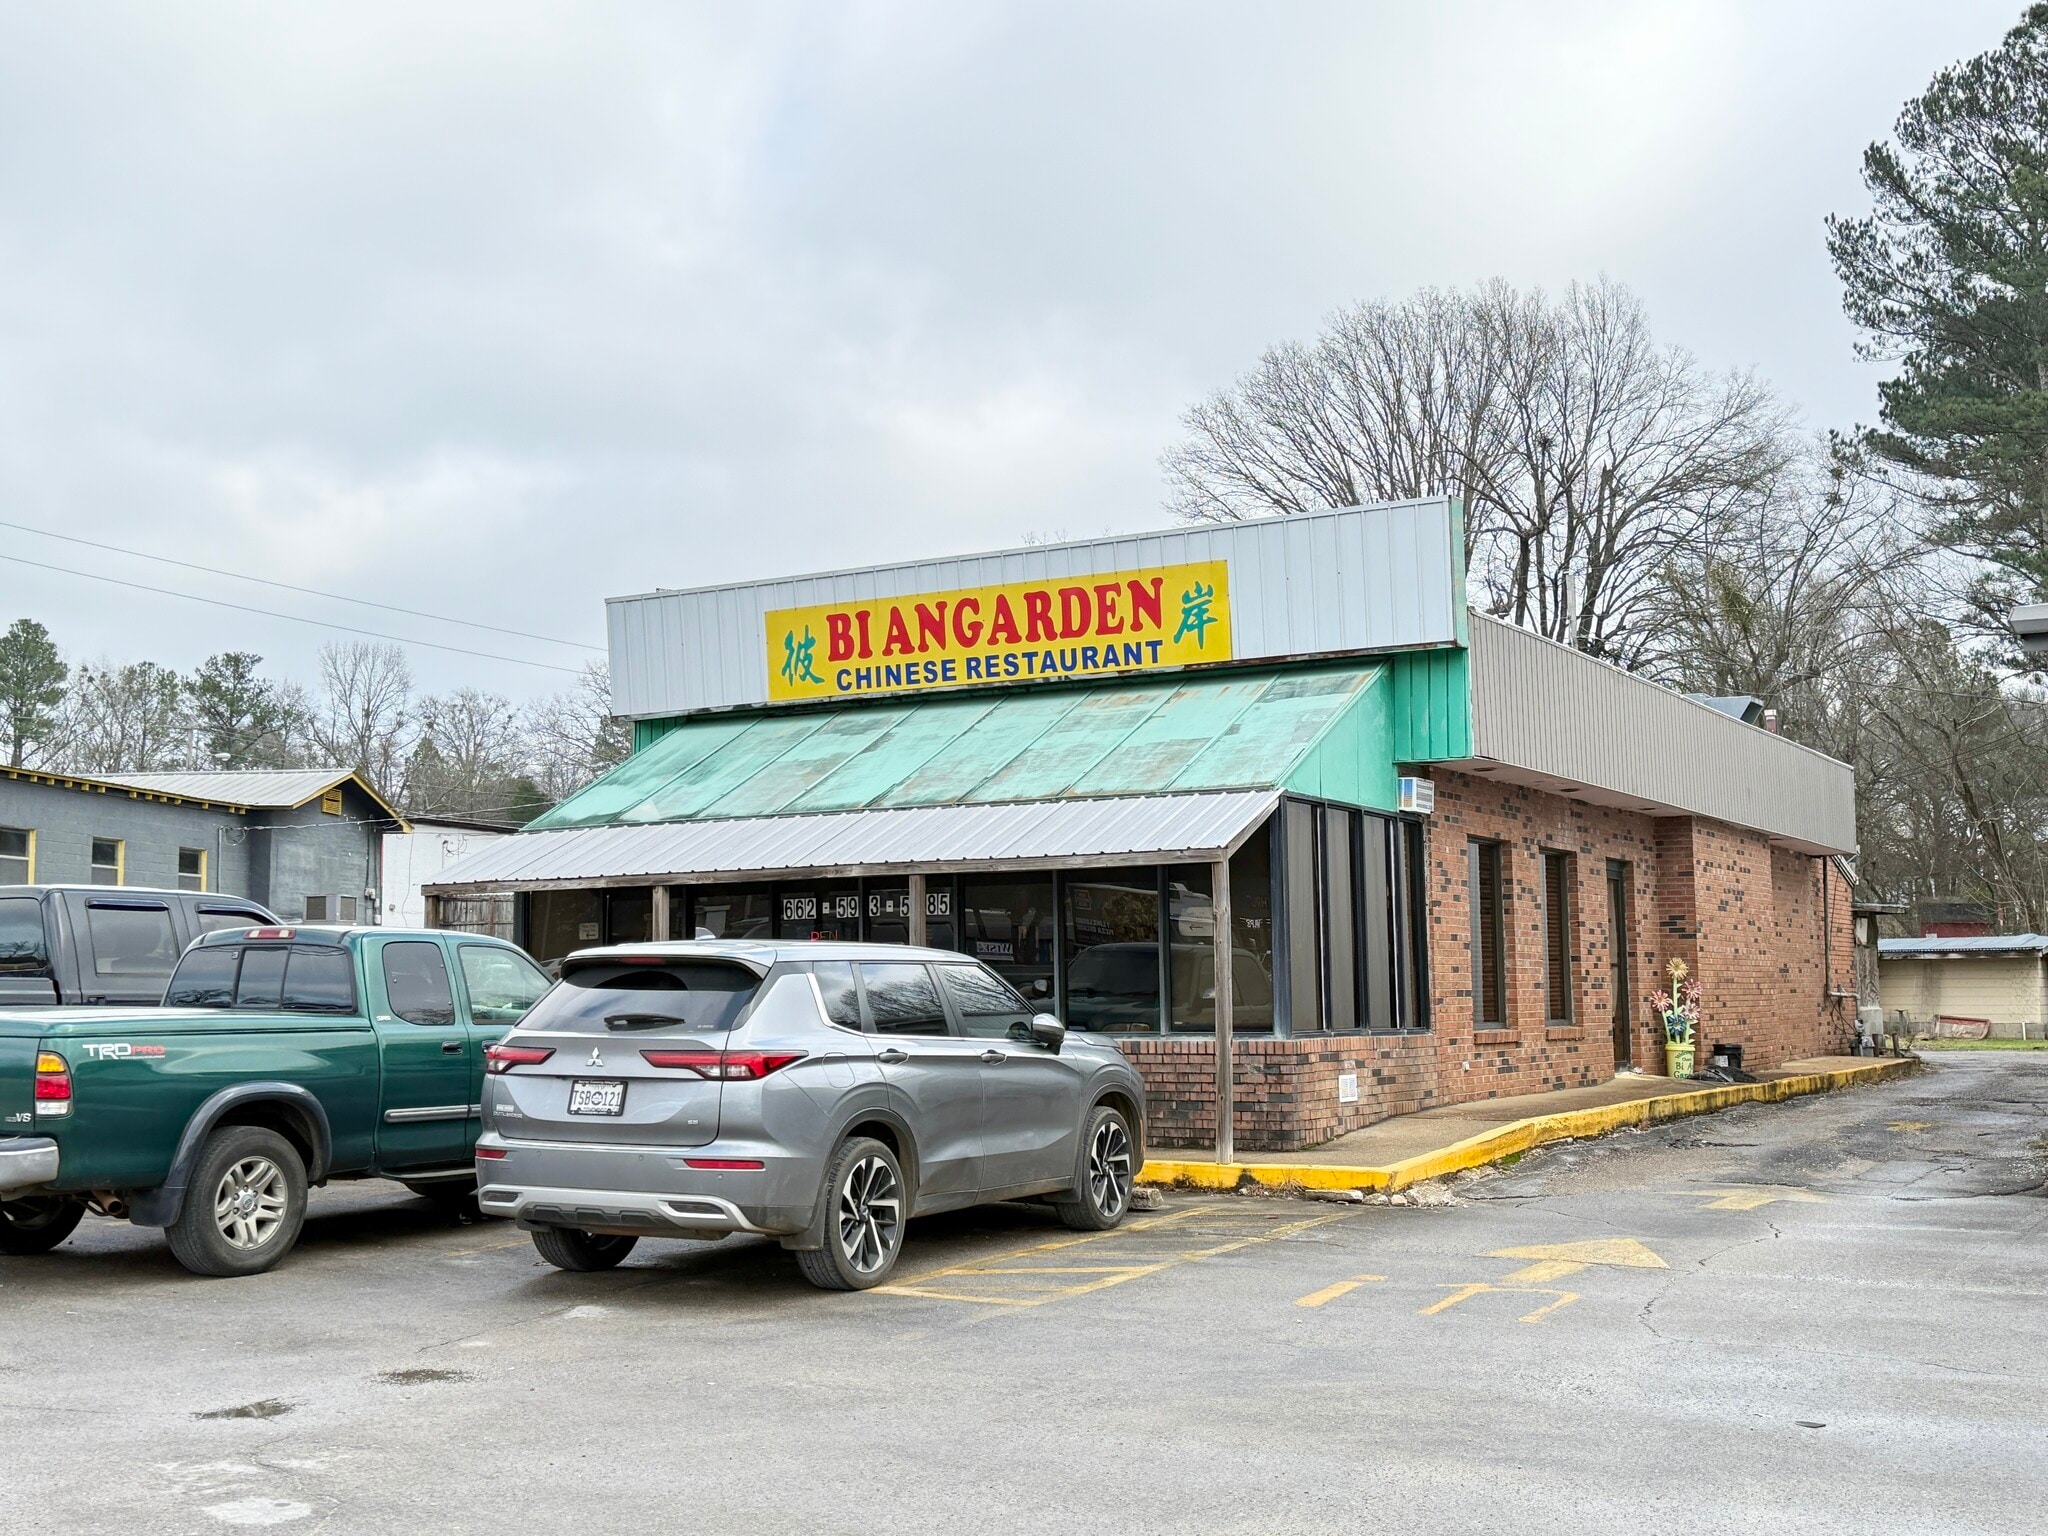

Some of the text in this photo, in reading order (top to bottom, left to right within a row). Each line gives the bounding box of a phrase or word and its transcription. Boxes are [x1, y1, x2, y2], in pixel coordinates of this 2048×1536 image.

[1173, 580, 1219, 650] 岸
[780, 624, 826, 687] 彼
[836, 640, 1164, 691] CHINESE RESTAURANT
[82, 1043, 166, 1060] TRD PRO
